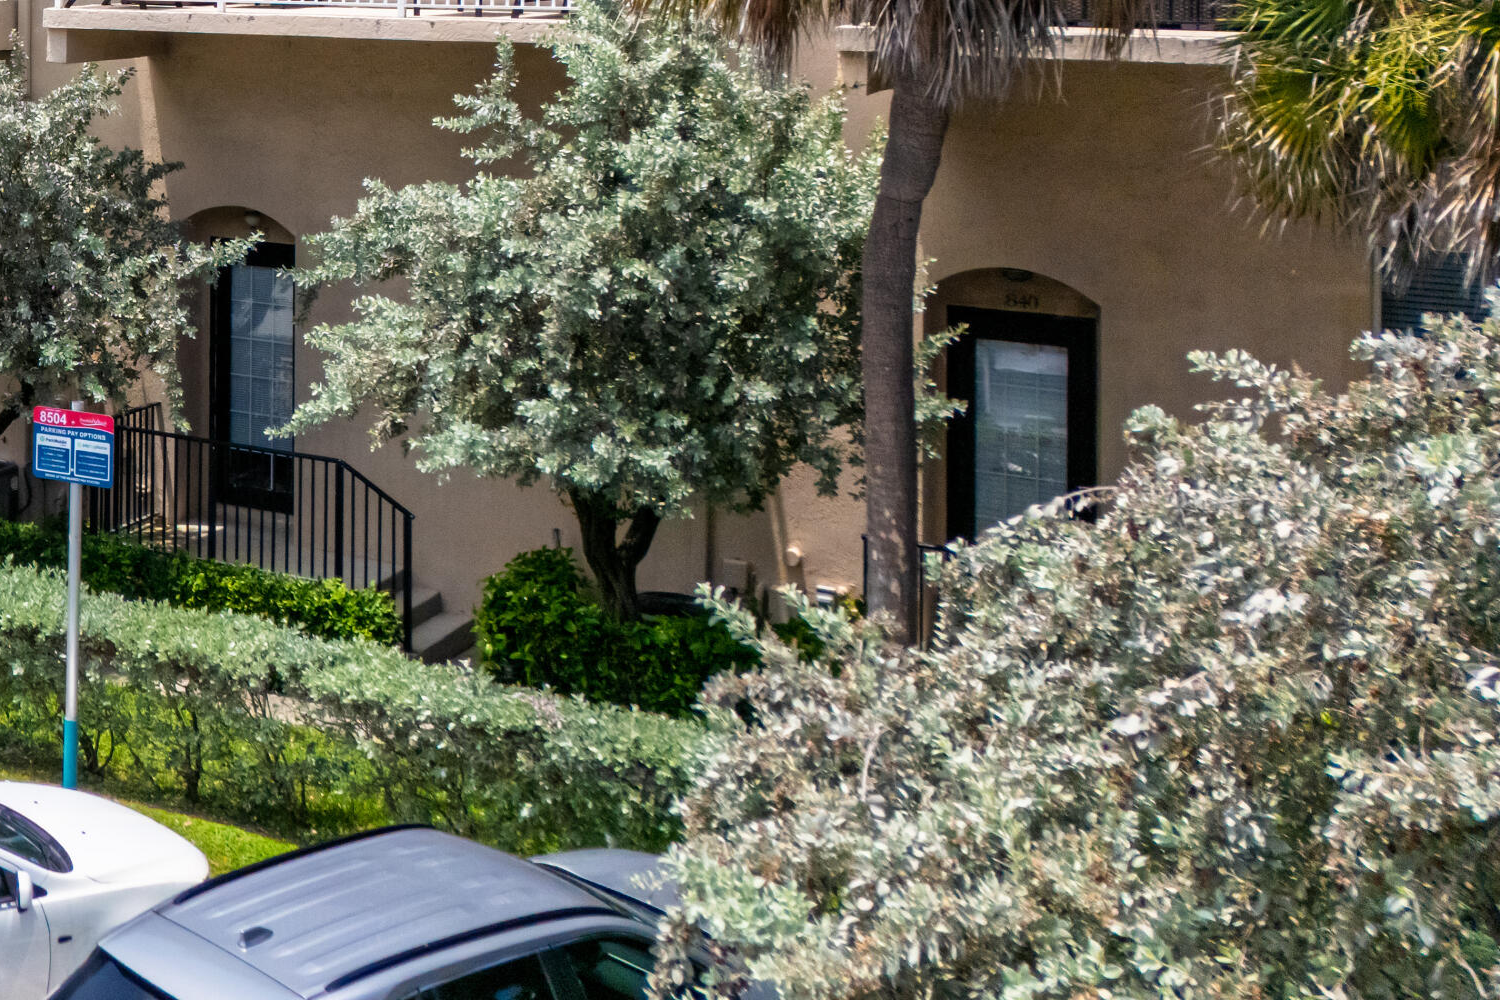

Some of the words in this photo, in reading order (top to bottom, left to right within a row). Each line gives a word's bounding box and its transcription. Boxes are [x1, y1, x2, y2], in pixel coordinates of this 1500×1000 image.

[39, 411, 67, 425] 8504
[40, 426, 67, 435] PARKING
[79, 432, 106, 441] OPTIONS
